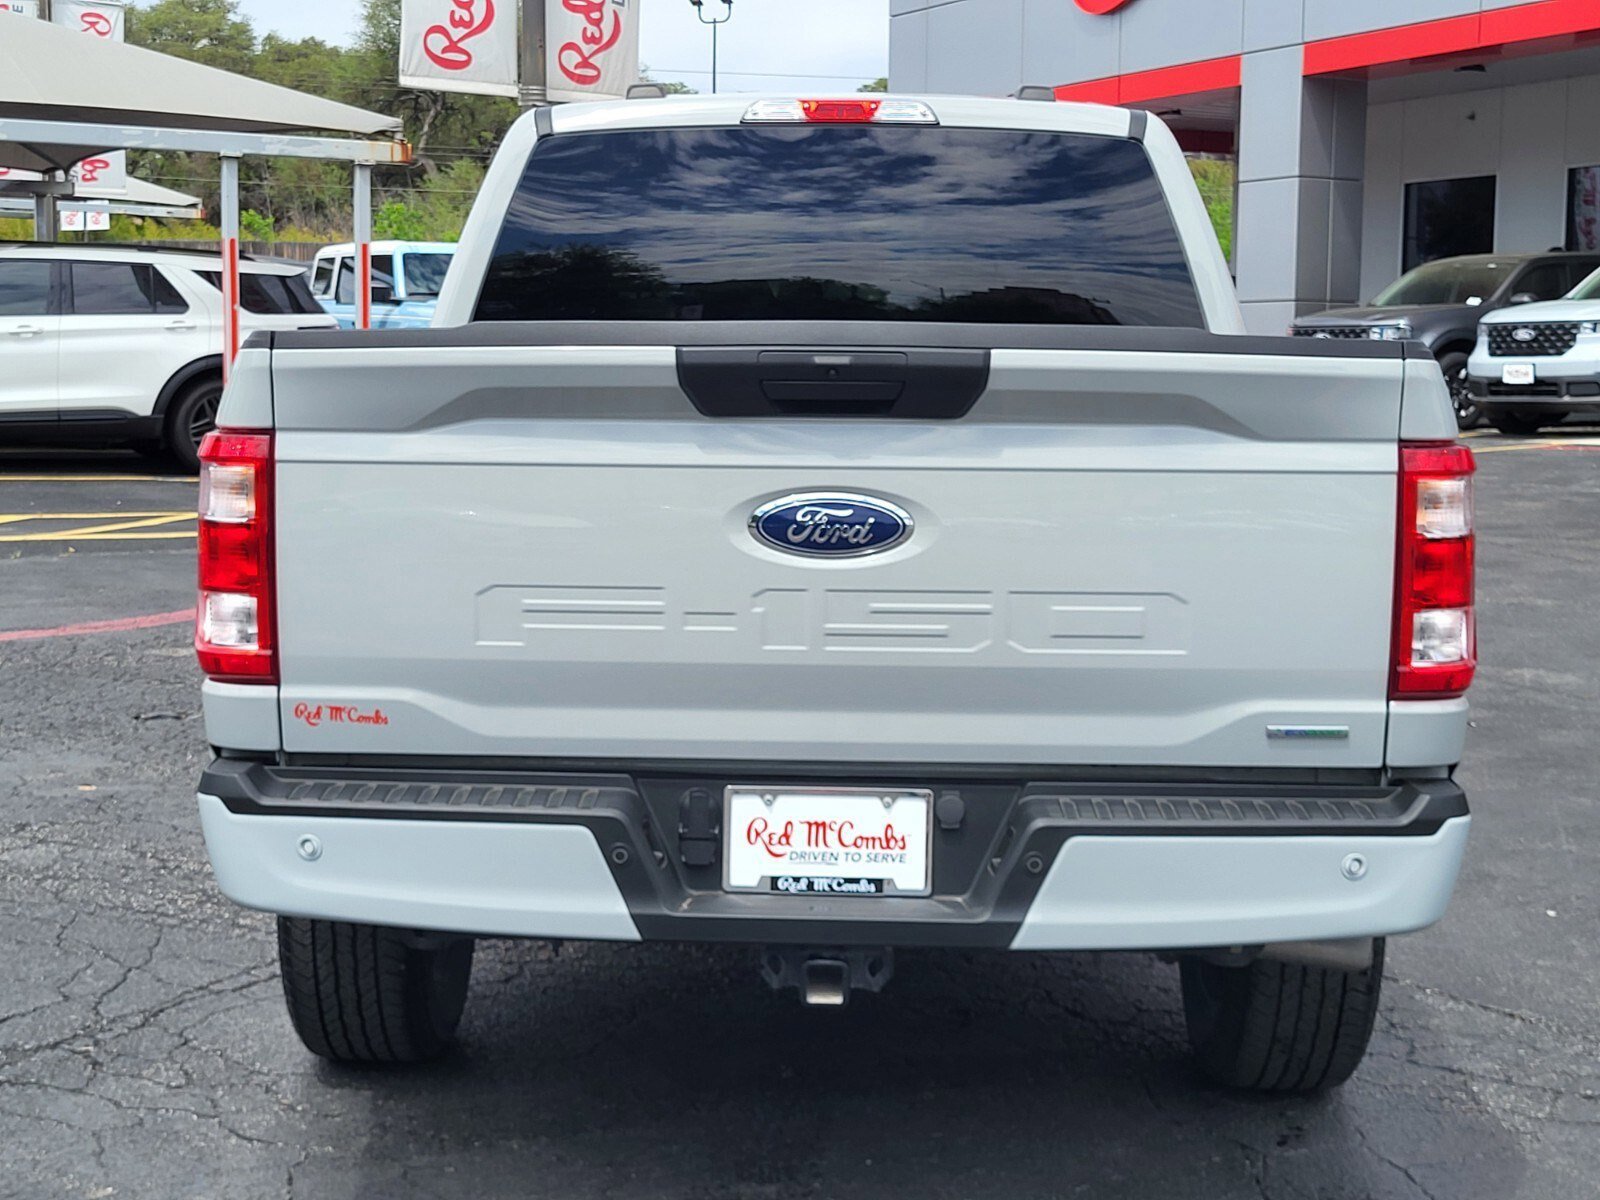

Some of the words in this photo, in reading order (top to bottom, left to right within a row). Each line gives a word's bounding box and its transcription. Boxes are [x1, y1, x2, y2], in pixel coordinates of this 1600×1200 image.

[786, 506, 876, 544] Ford
[294, 702, 322, 727] Red
[746, 816, 794, 858] Red
[799, 820, 907, 851] McCombs
[789, 850, 839, 863] DRIVEN
[844, 851, 863, 863] TO
[866, 851, 907, 864] SERVE
[776, 875, 808, 893] Red
